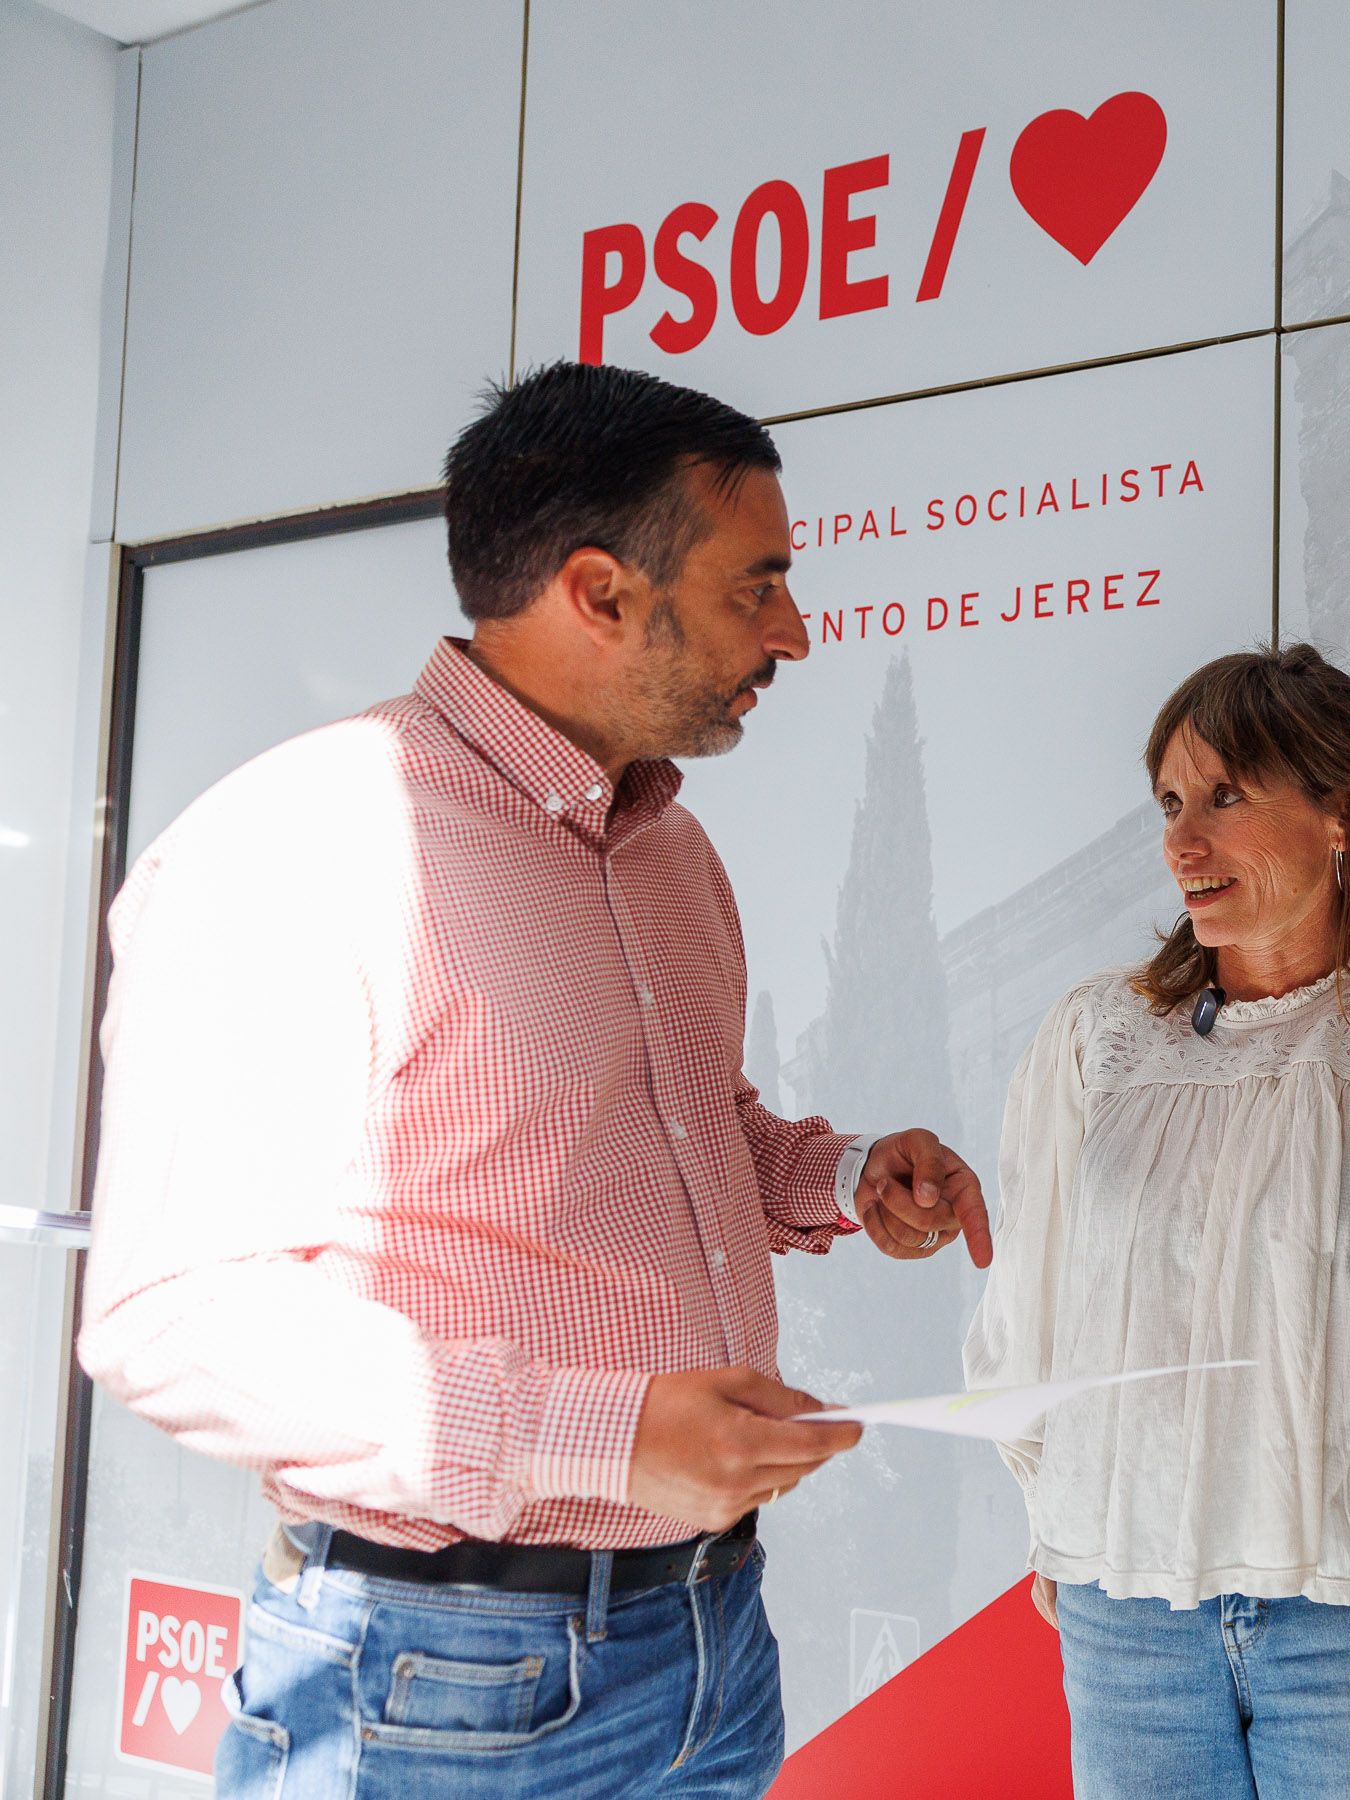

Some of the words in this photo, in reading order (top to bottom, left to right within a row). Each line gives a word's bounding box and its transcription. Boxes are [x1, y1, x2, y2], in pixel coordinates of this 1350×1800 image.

[578, 154, 891, 369] PSOE
[926, 459, 1204, 532] SOCIALISTA
[801, 601, 905, 644] NTO
[926, 591, 981, 632] DE
[999, 569, 1162, 623] JEREZ
[136, 1609, 229, 1680] PSOE
